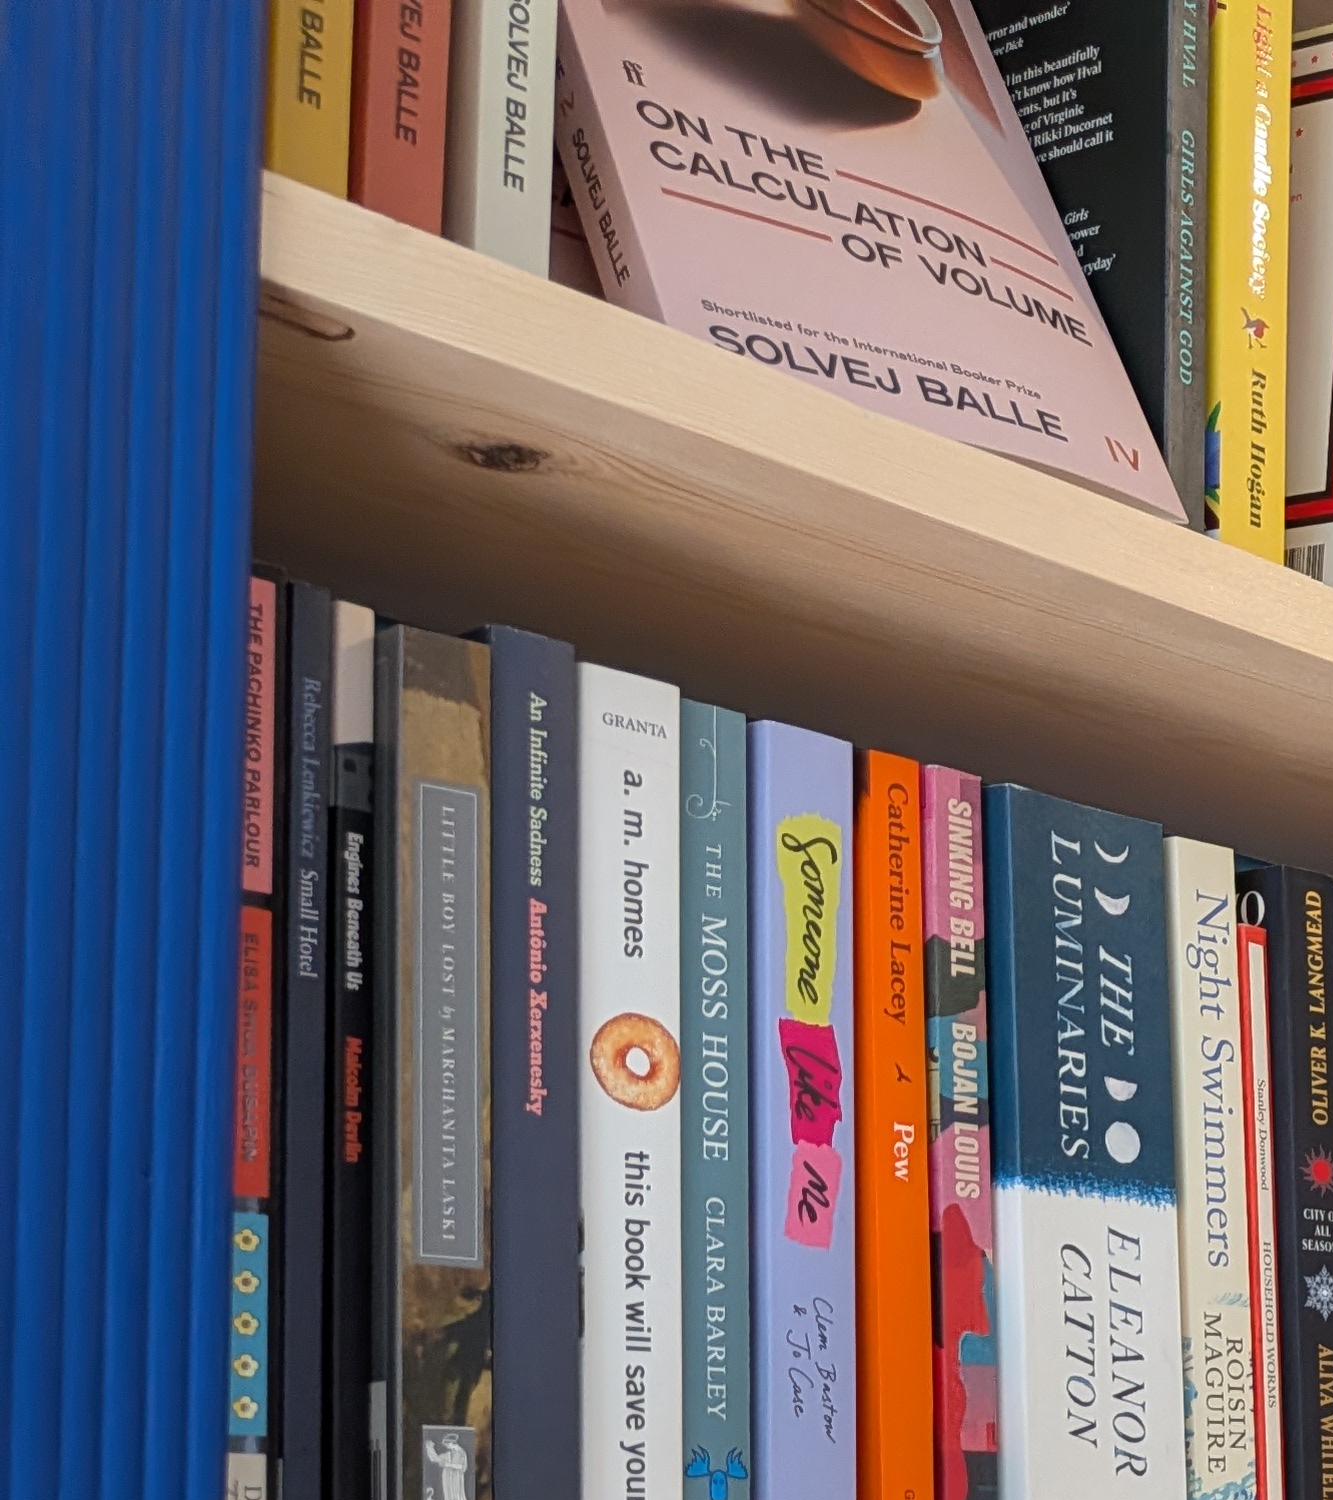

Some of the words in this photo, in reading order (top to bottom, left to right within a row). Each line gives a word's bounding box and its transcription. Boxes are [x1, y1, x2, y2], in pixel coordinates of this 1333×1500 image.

[636, 98, 711, 145] ON
[726, 124, 830, 181] THE
[1177, 128, 1196, 204] GIRLS
[649, 139, 988, 267] CALCULATION
[840, 231, 903, 270] OF
[918, 254, 1094, 348] VOLUME
[1177, 213, 1195, 325] AGAINST
[701, 299, 794, 333] Shortlisted
[797, 321, 821, 338] for
[823, 328, 850, 346] the
[852, 334, 948, 371] International
[950, 362, 1002, 387] Booker
[1005, 373, 1042, 400] Prize
[709, 324, 902, 395] SOLVEJ
[915, 372, 1069, 442] BALLE
[1178, 330, 1194, 387] GOD
[1104, 434, 1140, 472] IV
[1249, 368, 1269, 441] Ruth
[1244, 446, 1269, 529] Hogan
[705, 843, 723, 901] THE
[885, 782, 910, 932] Catherine
[700, 912, 729, 1022] MOSS
[882, 938, 912, 1025] Lacey
[1049, 829, 1090, 1163] LUMINARIES
[1097, 942, 1136, 1057] THE
[1184, 887, 1233, 1022] Night
[701, 1034, 729, 1163] HOUSE
[1197, 1026, 1236, 1270] Swimmers
[624, 1149, 650, 1208] this
[891, 1120, 915, 1182] Pew
[624, 1215, 652, 1290] book
[704, 1196, 726, 1296] CLARA
[1302, 1207, 1324, 1225] CITY
[1314, 1224, 1333, 1239] ALL
[624, 1299, 652, 1353] will
[705, 1304, 728, 1421] BARLEY
[1058, 1242, 1099, 1449] CATTON
[1105, 1224, 1149, 1479] ELEANOR
[625, 1364, 647, 1432] save
[1202, 1310, 1227, 1474] MAGUIRE
[1225, 1335, 1248, 1452] ROISIN
